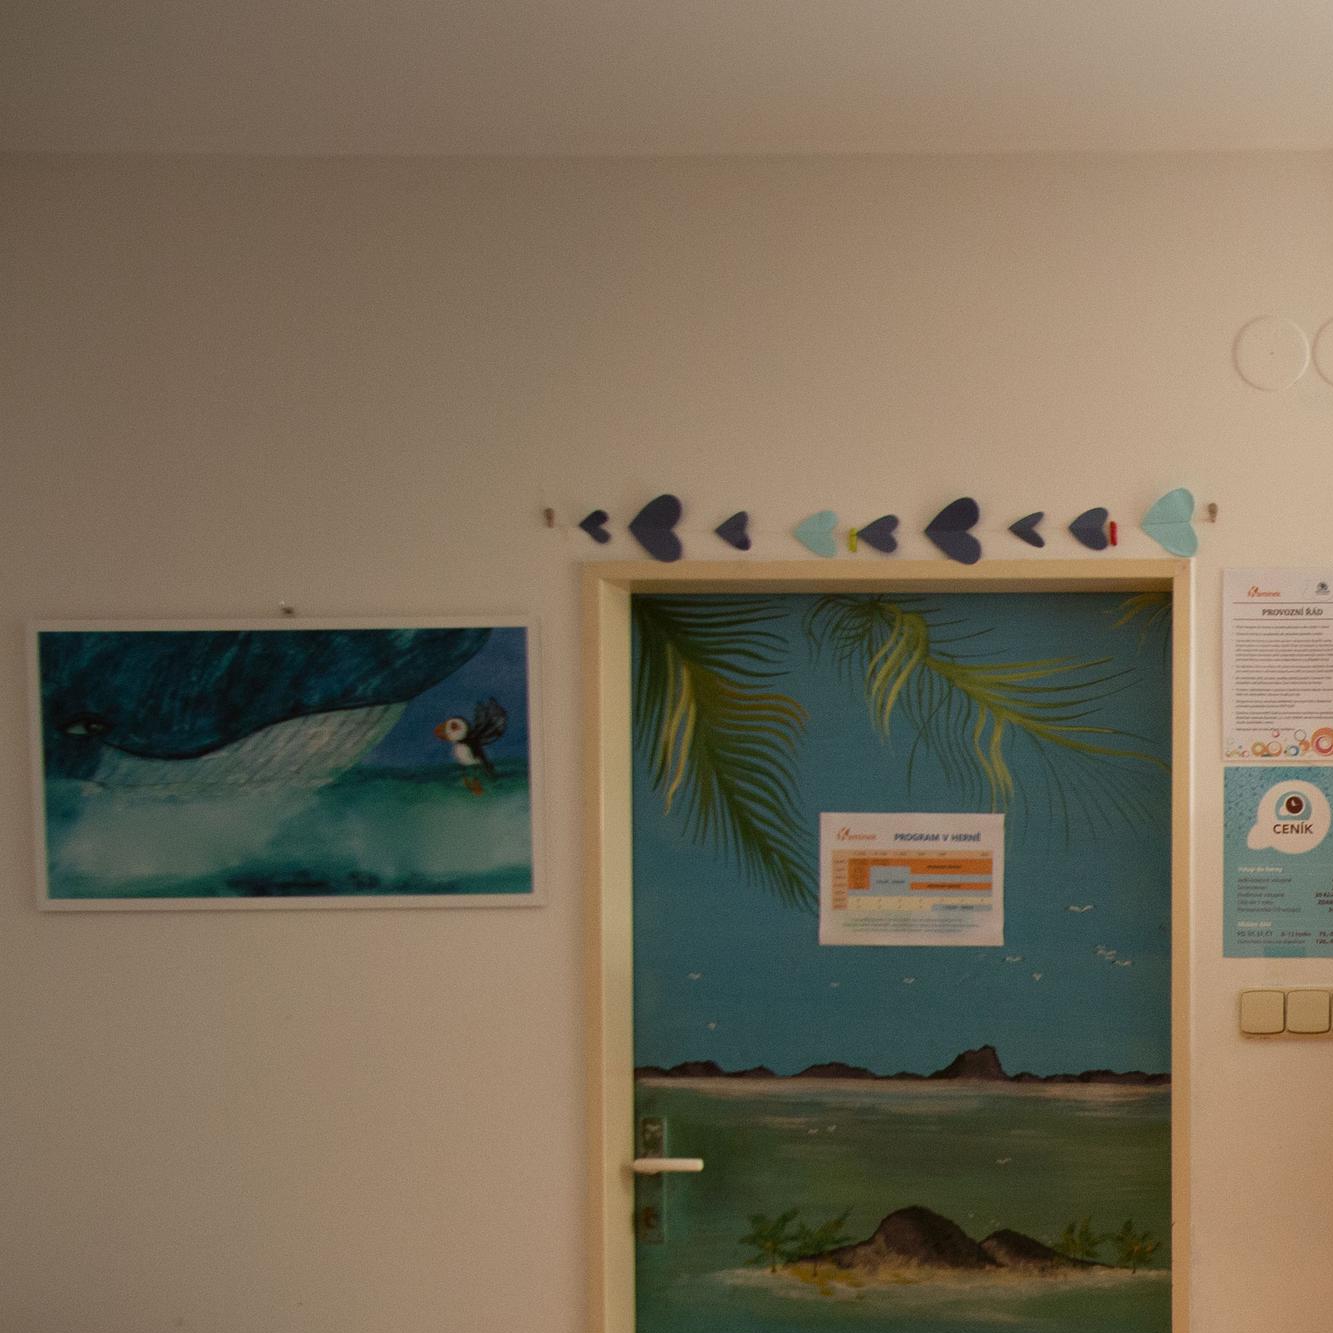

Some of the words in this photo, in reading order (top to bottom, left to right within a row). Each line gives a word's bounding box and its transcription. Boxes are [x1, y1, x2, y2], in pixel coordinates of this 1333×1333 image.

[1262, 607, 1303, 616] PROVOZNÍ
[1305, 606, 1323, 616] ŘÁD
[1273, 821, 1314, 834] CENÍK
[894, 833, 940, 842] PROGRAM
